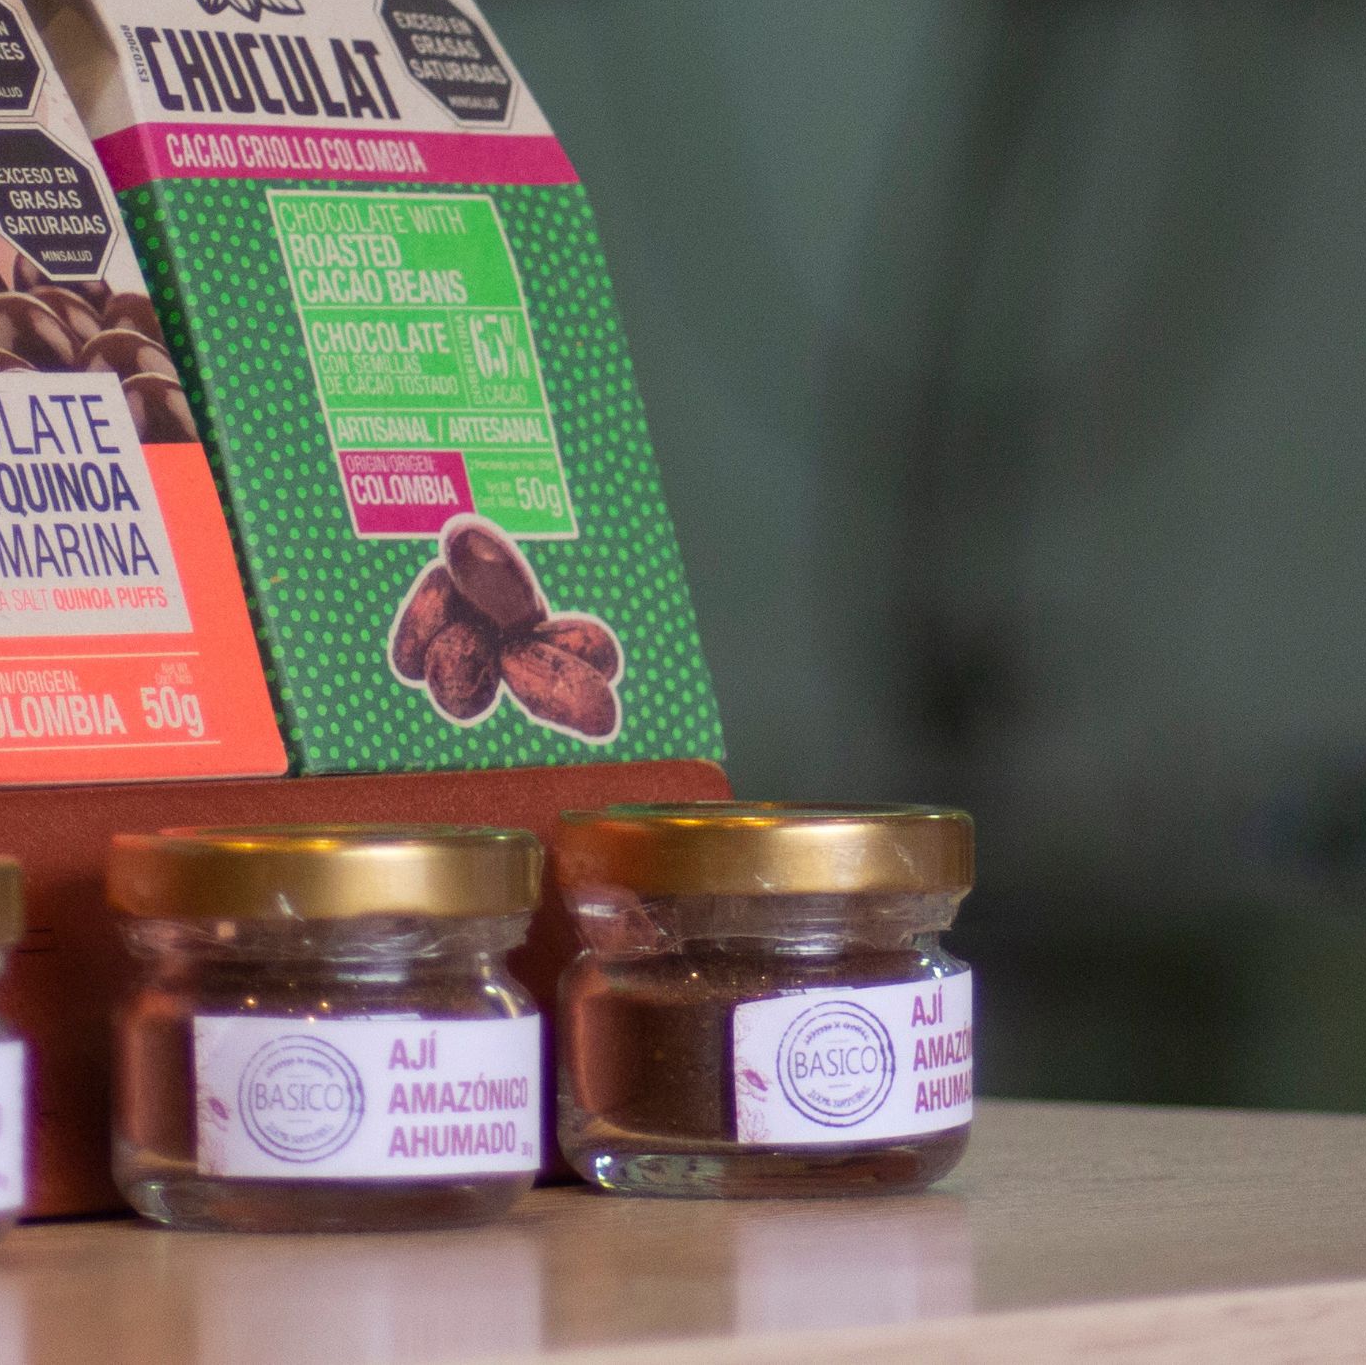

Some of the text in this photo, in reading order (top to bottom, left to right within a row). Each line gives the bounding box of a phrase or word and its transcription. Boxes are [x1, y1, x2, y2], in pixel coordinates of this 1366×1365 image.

[135, 26, 402, 121] CHUCULAT
[166, 134, 428, 174] CACAO CRIOLLO COLOMBIA
[55, 167, 79, 185] EN
[9, 190, 82, 210] GRASAS
[4, 215, 107, 236] SATURADAS
[278, 201, 467, 234] CHOCOLATE WITH
[40, 250, 93, 263] MINSALUD
[288, 233, 403, 267] ROASTED
[297, 269, 469, 304] CACAO BEANS
[311, 321, 452, 354] CHOCOLATE
[337, 416, 435, 443] ARTISANAL
[448, 416, 549, 443] ARTESANAL
[350, 474, 460, 506] COLOMBIA
[514, 476, 564, 518] 50g
[11, 588, 50, 613] SALT
[53, 587, 116, 611] QUINOA
[117, 586, 169, 610] PUFFS
[140, 685, 205, 738] 50g
[910, 984, 943, 1028] AJÍ
[387, 1030, 438, 1071] AJÍ
[794, 1045, 879, 1080] BASICO
[255, 1083, 344, 1111] BASICO
[387, 1071, 529, 1116] AMAZÓNICO
[387, 1120, 516, 1159] AHUMADO
